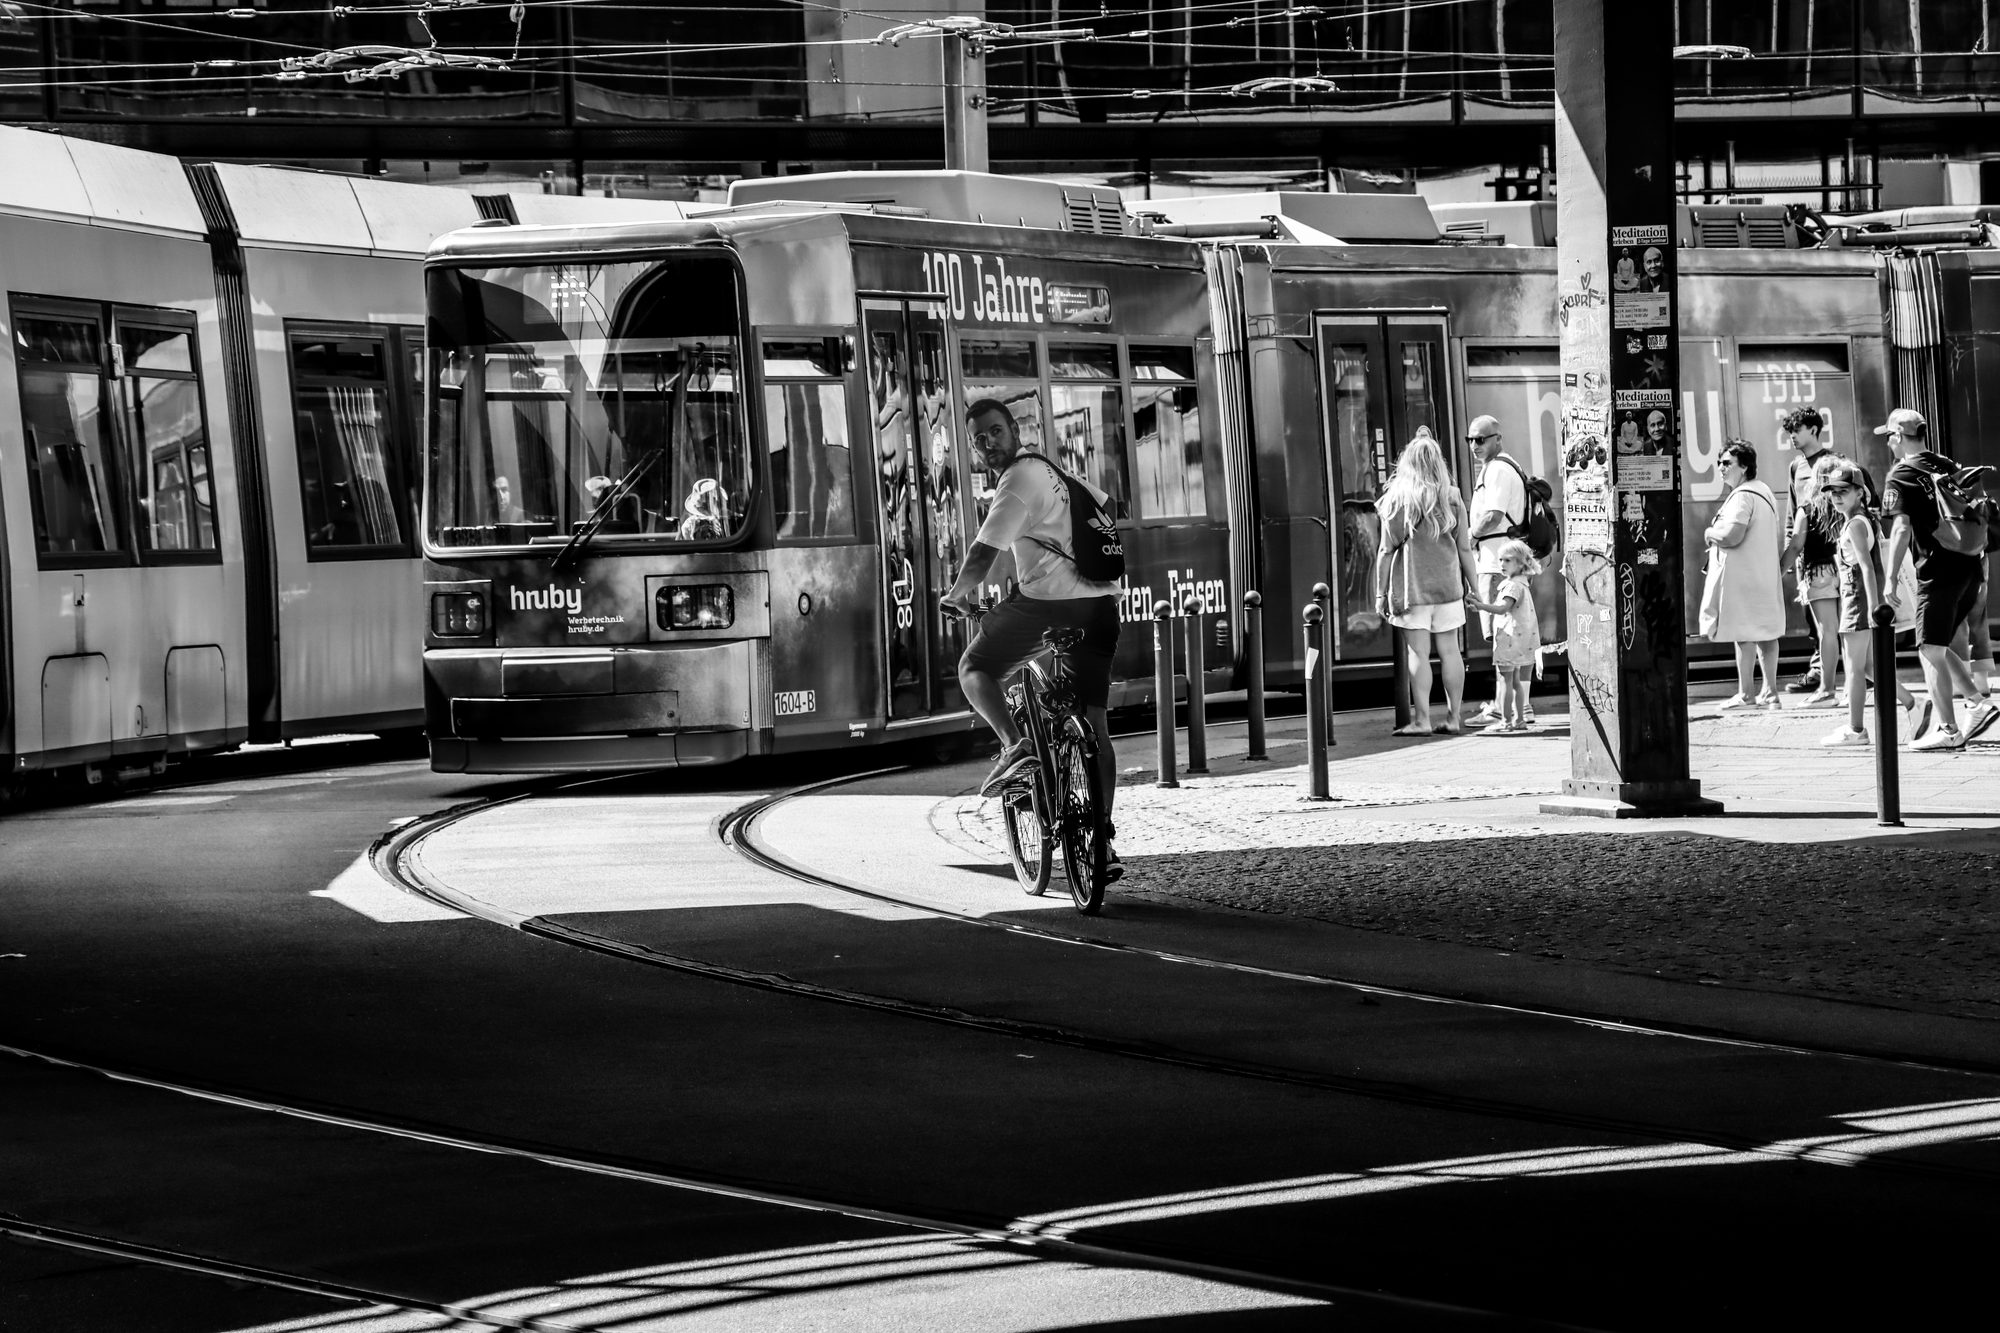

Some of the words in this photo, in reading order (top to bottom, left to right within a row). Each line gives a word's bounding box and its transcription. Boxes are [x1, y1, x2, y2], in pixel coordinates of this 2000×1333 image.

[1613, 228, 1667, 238] Meditation
[922, 252, 965, 320] 100
[972, 254, 1044, 324] Jahre
[1757, 363, 1816, 403] 1919
[1616, 391, 1670, 401] Meditation
[1775, 407, 1834, 451] 29
[1568, 505, 1606, 513] BERLIN
[510, 583, 582, 615] hruby
[1168, 568, 1227, 618] Fräsen
[567, 615, 625, 625] Werbetechnik
[567, 625, 605, 635] hruby.de
[774, 691, 815, 715] 1604-B
